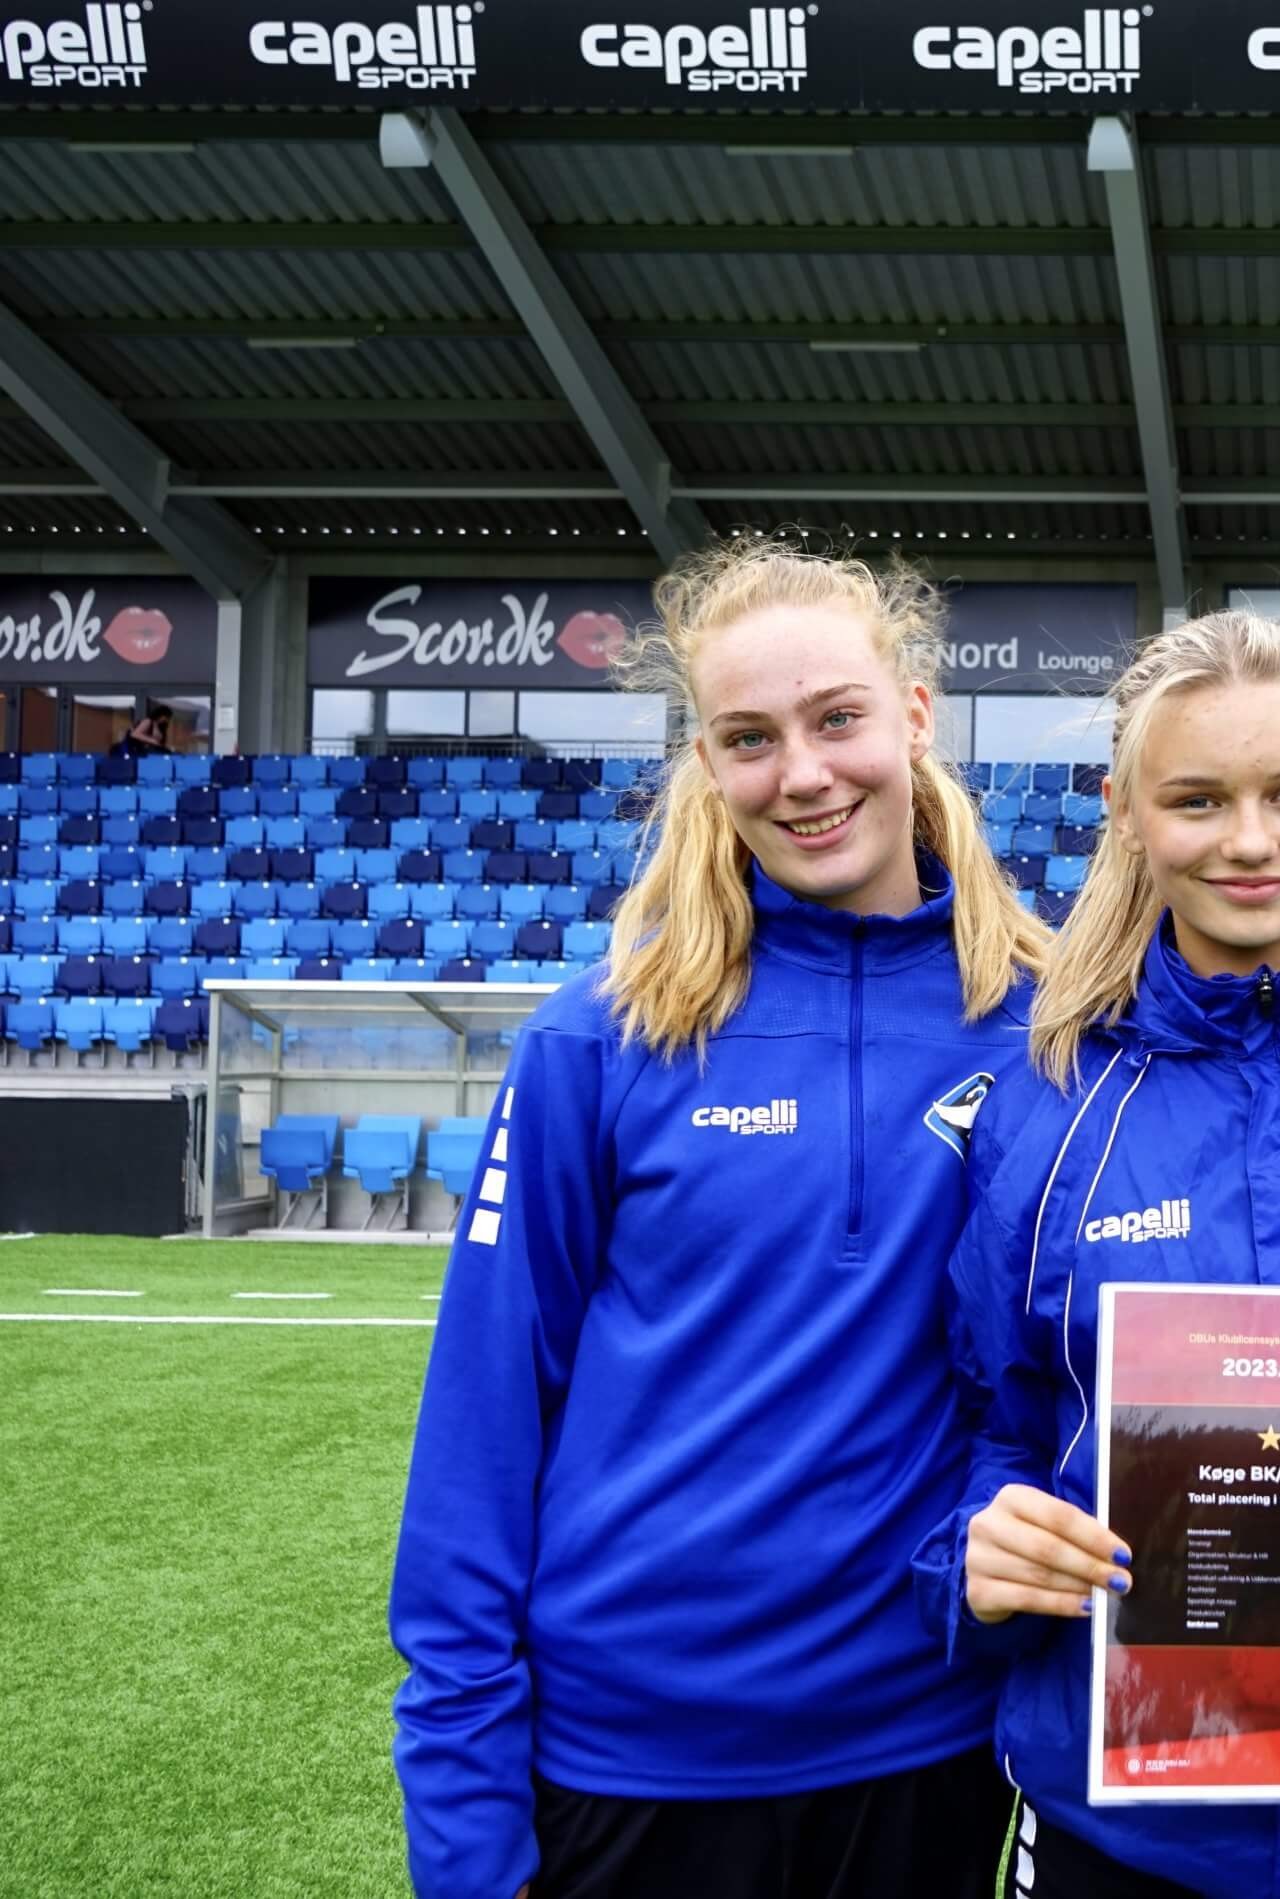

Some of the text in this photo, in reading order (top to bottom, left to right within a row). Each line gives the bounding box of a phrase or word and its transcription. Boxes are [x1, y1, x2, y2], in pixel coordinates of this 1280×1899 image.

[0, 1, 147, 80] pelli
[249, 2, 476, 82] capelli
[580, 5, 807, 86] capelli
[912, 6, 1141, 88] capelli
[30, 64, 148, 88] SPORT
[356, 66, 477, 89] SPORT
[687, 69, 808, 93] SPORT
[1019, 71, 1141, 94] SPORT
[345, 584, 556, 678] Scor.dk
[1038, 651, 1113, 674] Lounge
[692, 1099, 797, 1133] capelli
[739, 1124, 798, 1135] SPORT
[1085, 1198, 1190, 1242] capelli
[1132, 1227, 1191, 1243] SPORT
[1199, 1465, 1246, 1485] Køge
[1188, 1492, 1216, 1504] Total
[1218, 1493, 1270, 1507] placering
